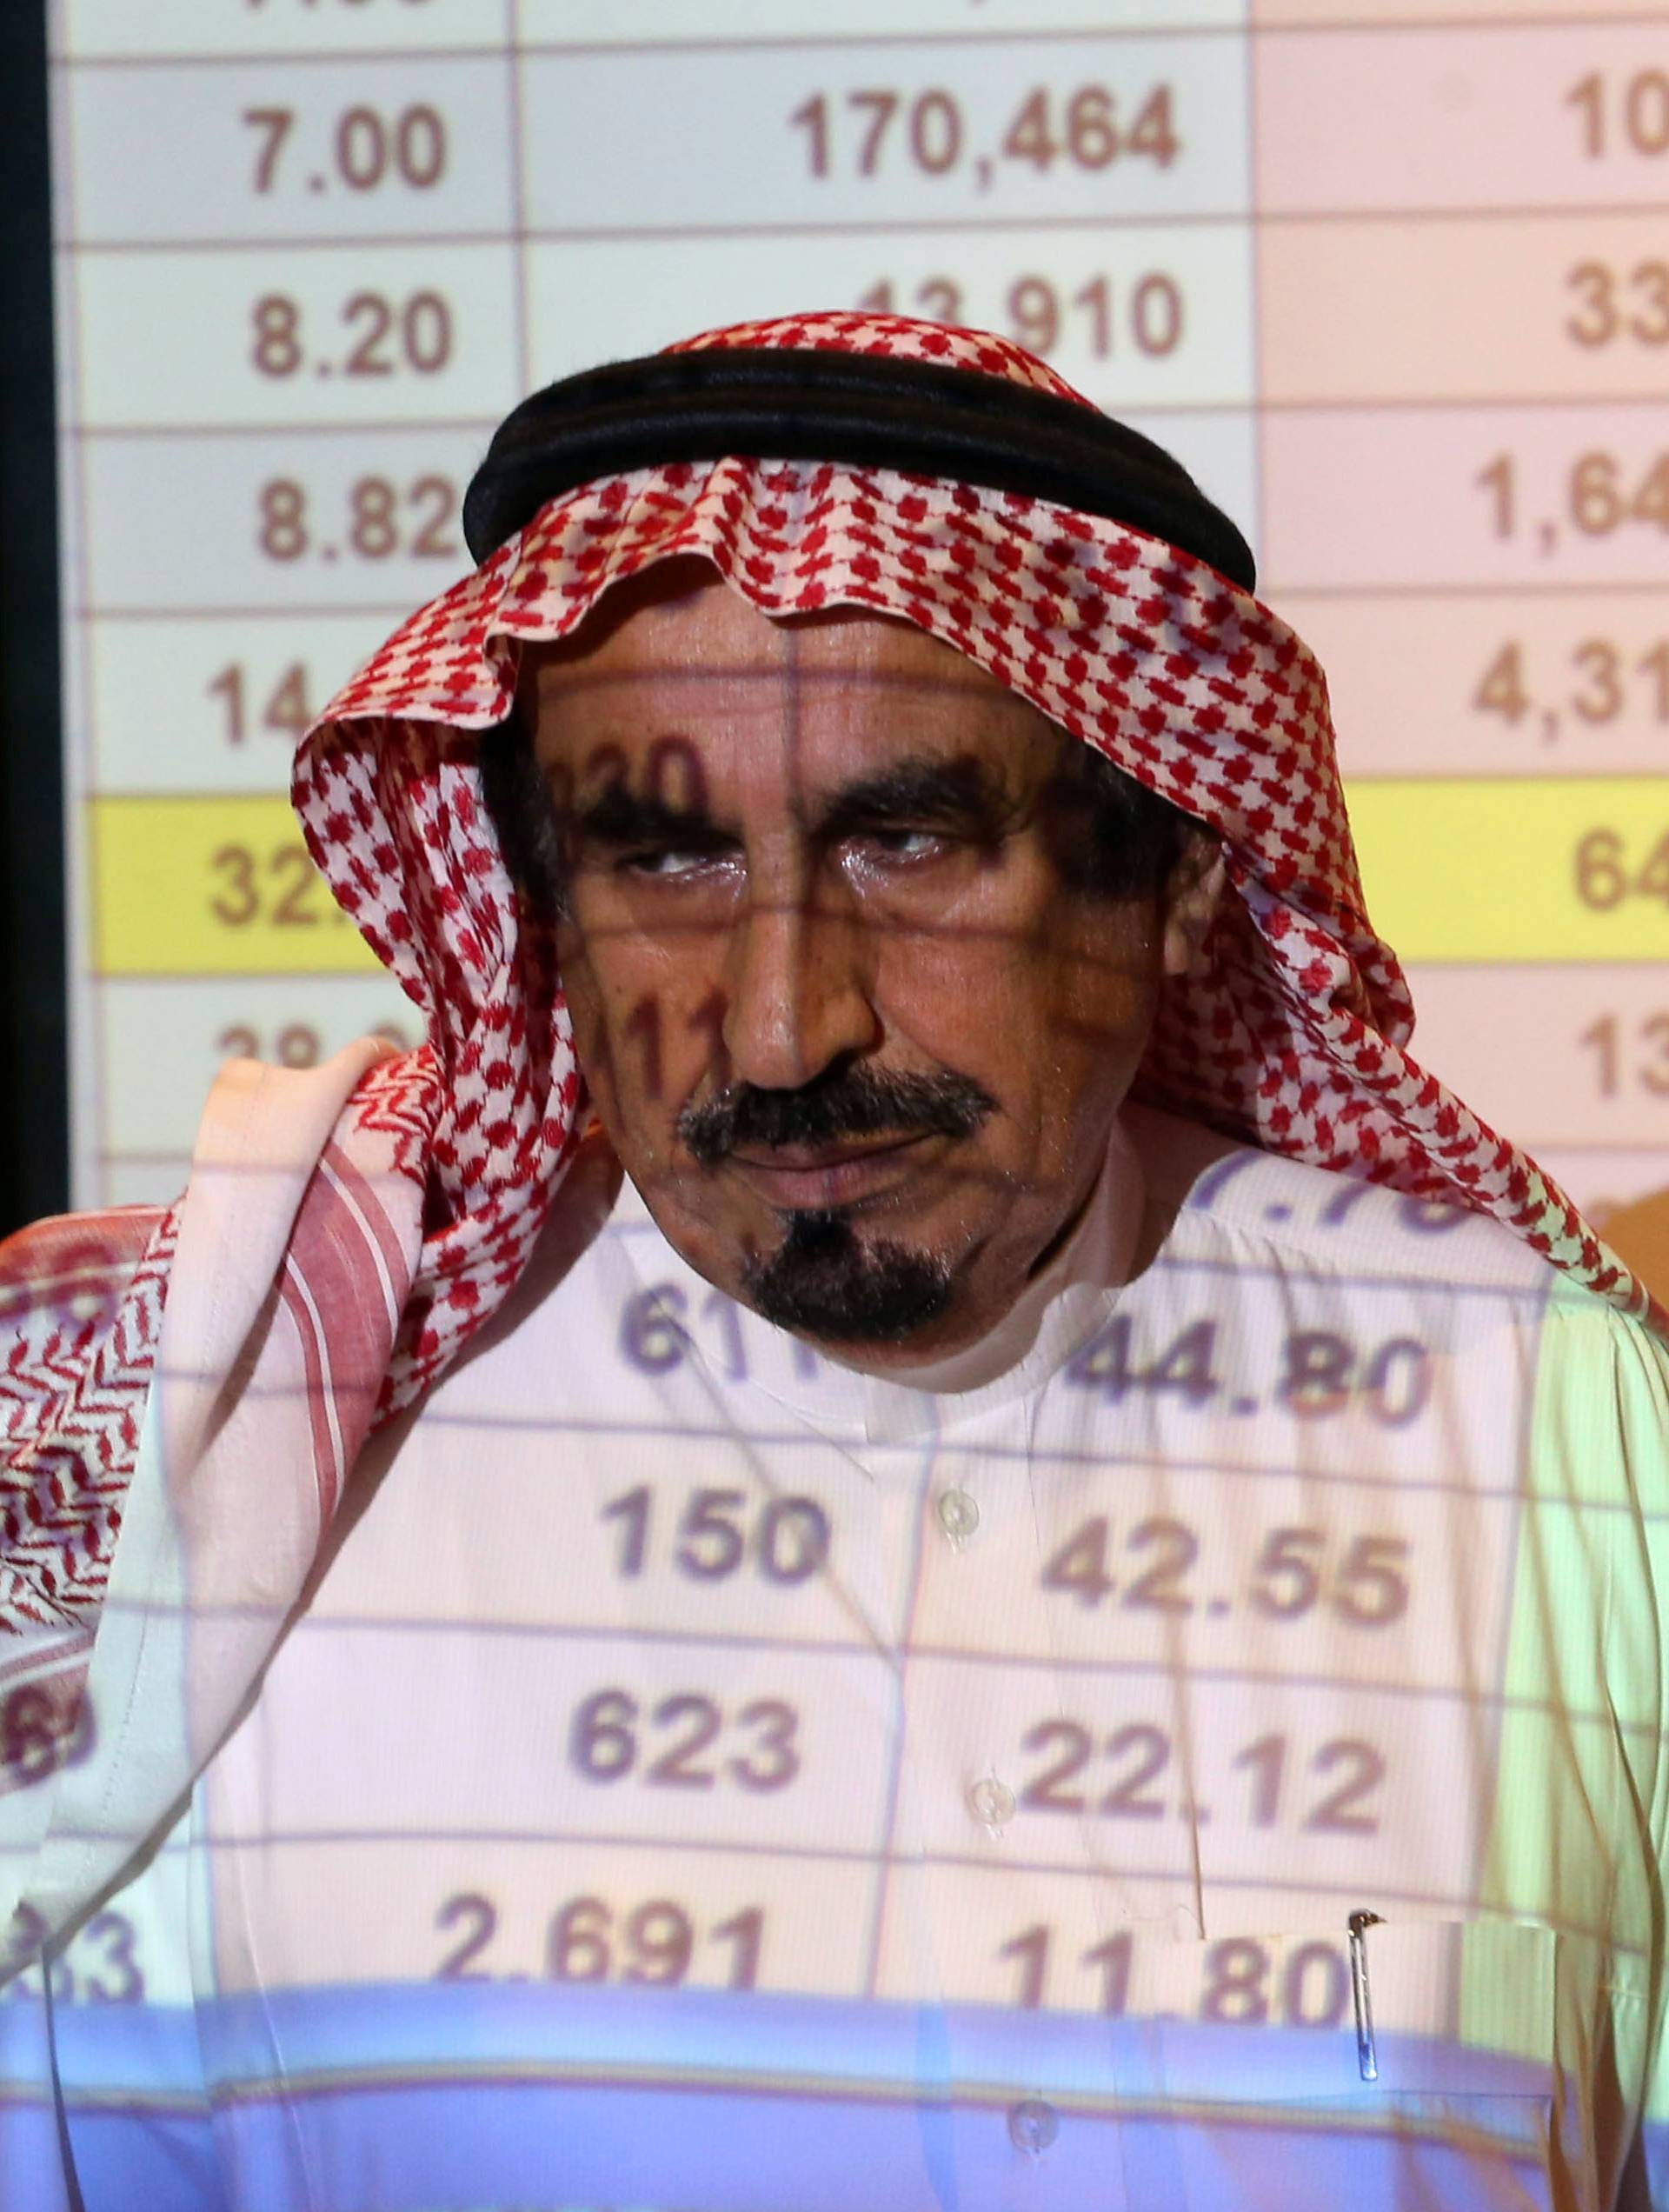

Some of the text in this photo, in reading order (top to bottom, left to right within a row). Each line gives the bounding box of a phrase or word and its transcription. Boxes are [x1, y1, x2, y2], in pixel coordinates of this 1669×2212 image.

[243, 103, 447, 194] 7.00
[789, 81, 1180, 189] 170,464
[250, 291, 452, 379] 8.20
[260, 477, 457, 563] 8.82
[1066, 1315, 1434, 1430] 44.80
[600, 1485, 832, 1585] 150
[1041, 1516, 1412, 1629] 42.55
[568, 1689, 801, 1792] 623
[1019, 1719, 1388, 1836] 22.12
